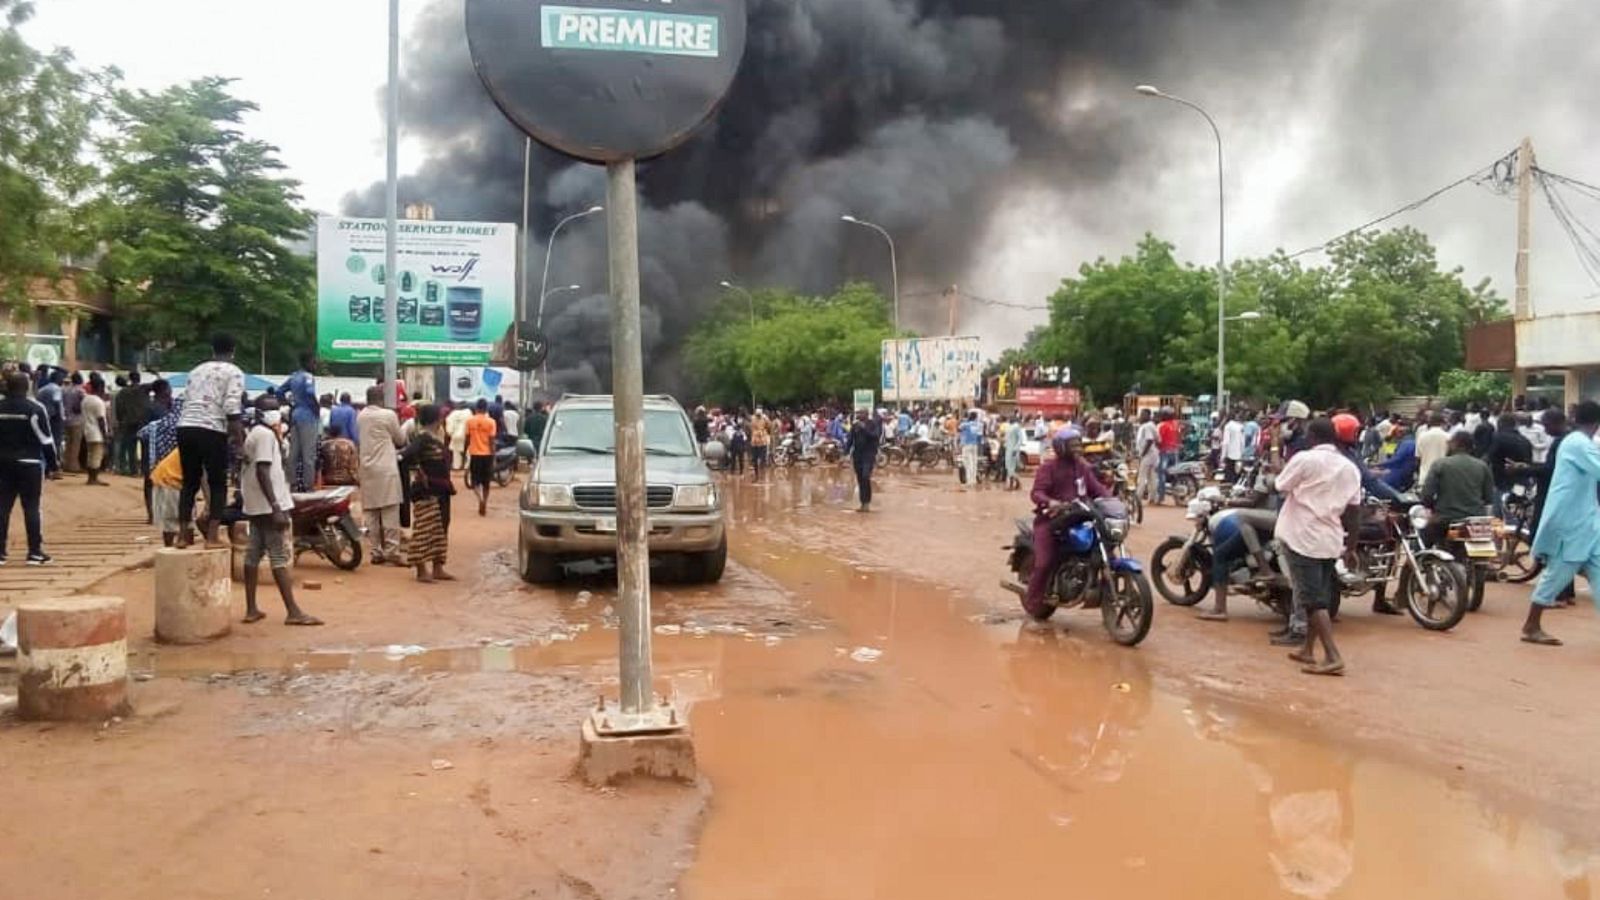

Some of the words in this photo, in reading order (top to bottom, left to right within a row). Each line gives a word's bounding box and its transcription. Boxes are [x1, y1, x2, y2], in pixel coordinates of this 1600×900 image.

[558, 13, 712, 50] PREMIERE
[398, 224, 452, 235] SERVICES
[456, 226, 498, 236] MOREY
